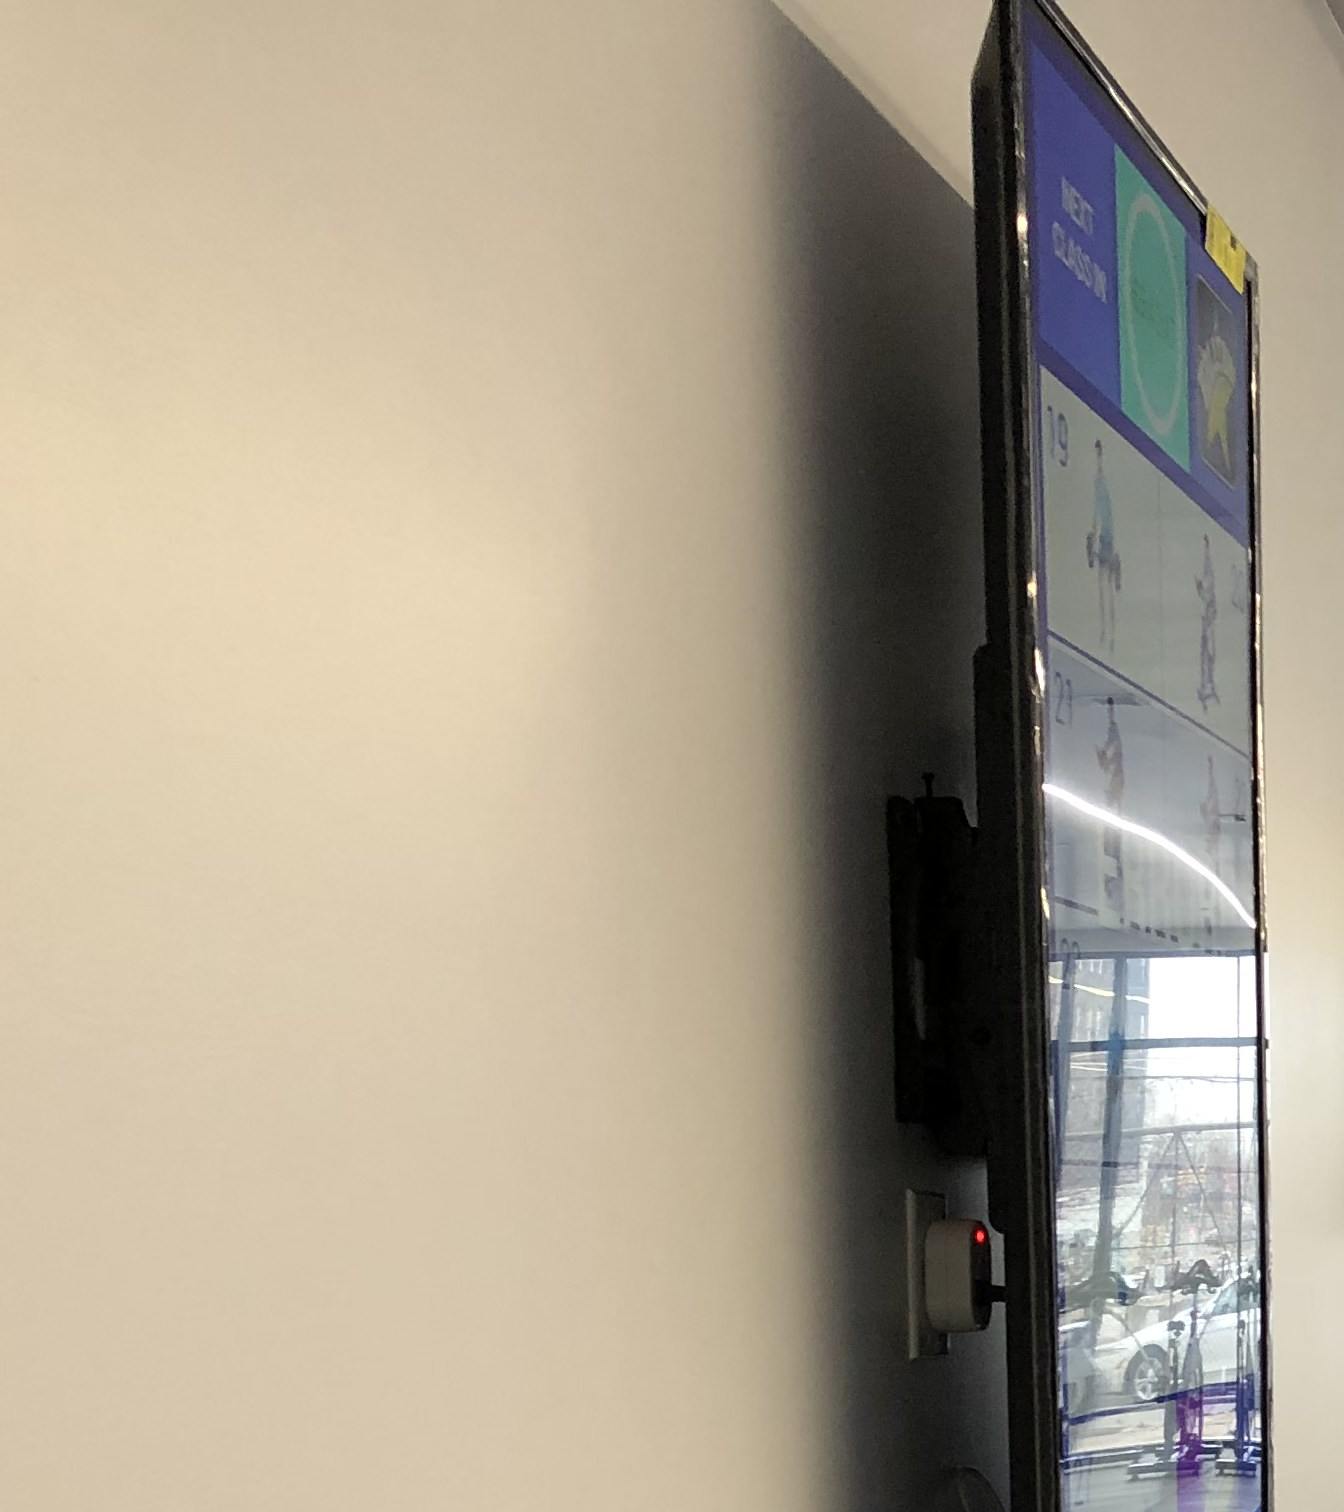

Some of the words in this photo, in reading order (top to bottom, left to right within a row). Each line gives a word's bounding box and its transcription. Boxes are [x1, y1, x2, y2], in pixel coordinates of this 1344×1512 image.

[1060, 175, 1094, 236] NEXT
[1051, 221, 1091, 289] CLASS
[1047, 405, 1069, 468] 19
